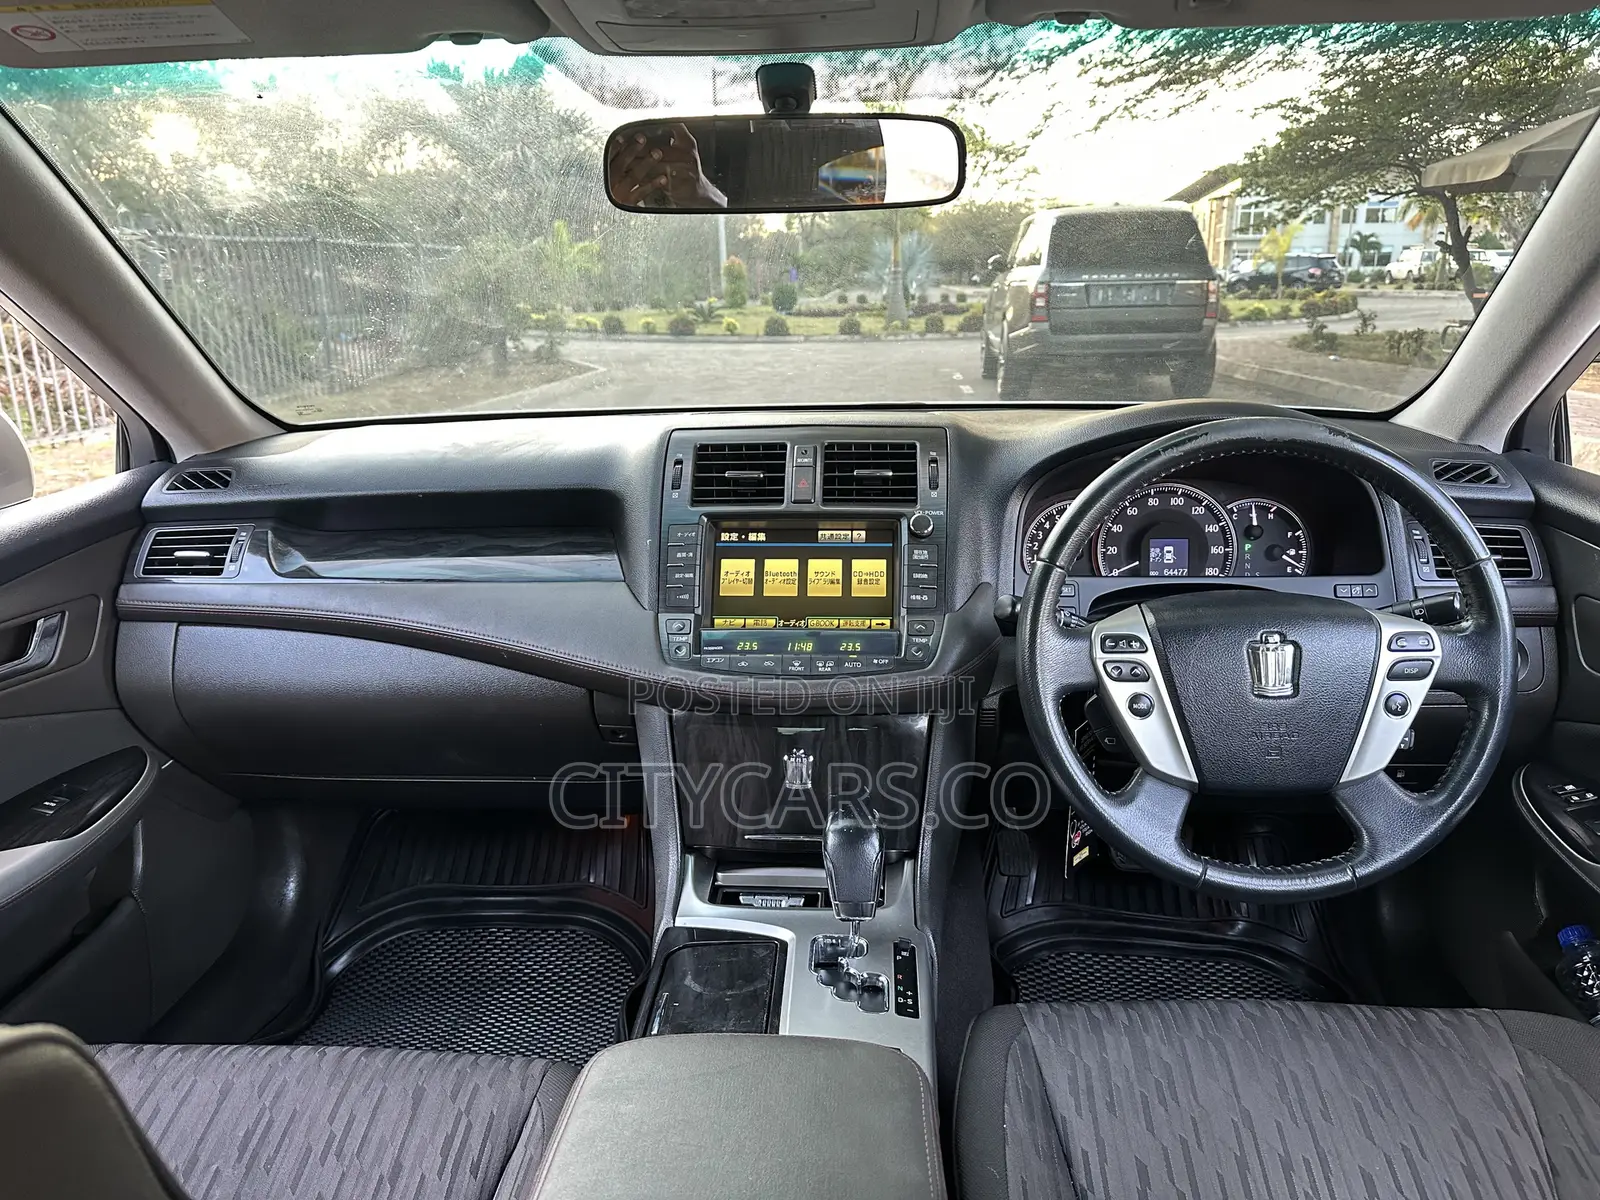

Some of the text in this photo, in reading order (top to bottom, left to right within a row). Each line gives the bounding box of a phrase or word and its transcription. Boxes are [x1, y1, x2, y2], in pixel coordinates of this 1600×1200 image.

[1147, 498, 1159, 506] 80
[1170, 498, 1184, 506] 100
[1126, 507, 1138, 516] 60
[1191, 507, 1205, 515] 120
[1043, 521, 1050, 530] 4
[1110, 524, 1123, 533] 40
[1204, 524, 1219, 533] 140
[1037, 531, 1043, 540] 3
[1033, 542, 1039, 550] 2
[1106, 546, 1118, 555] 20
[1210, 545, 1224, 555] 160
[1244, 543, 1252, 552] P
[1163, 568, 1188, 576] 64477
[1205, 567, 1219, 576] 180
[778, 619, 806, 628] オーディオ
[737, 642, 758, 650] 23.5
[787, 642, 813, 651] 11:48
[840, 643, 861, 651] 23.5
[1132, 702, 1148, 710] MODE
